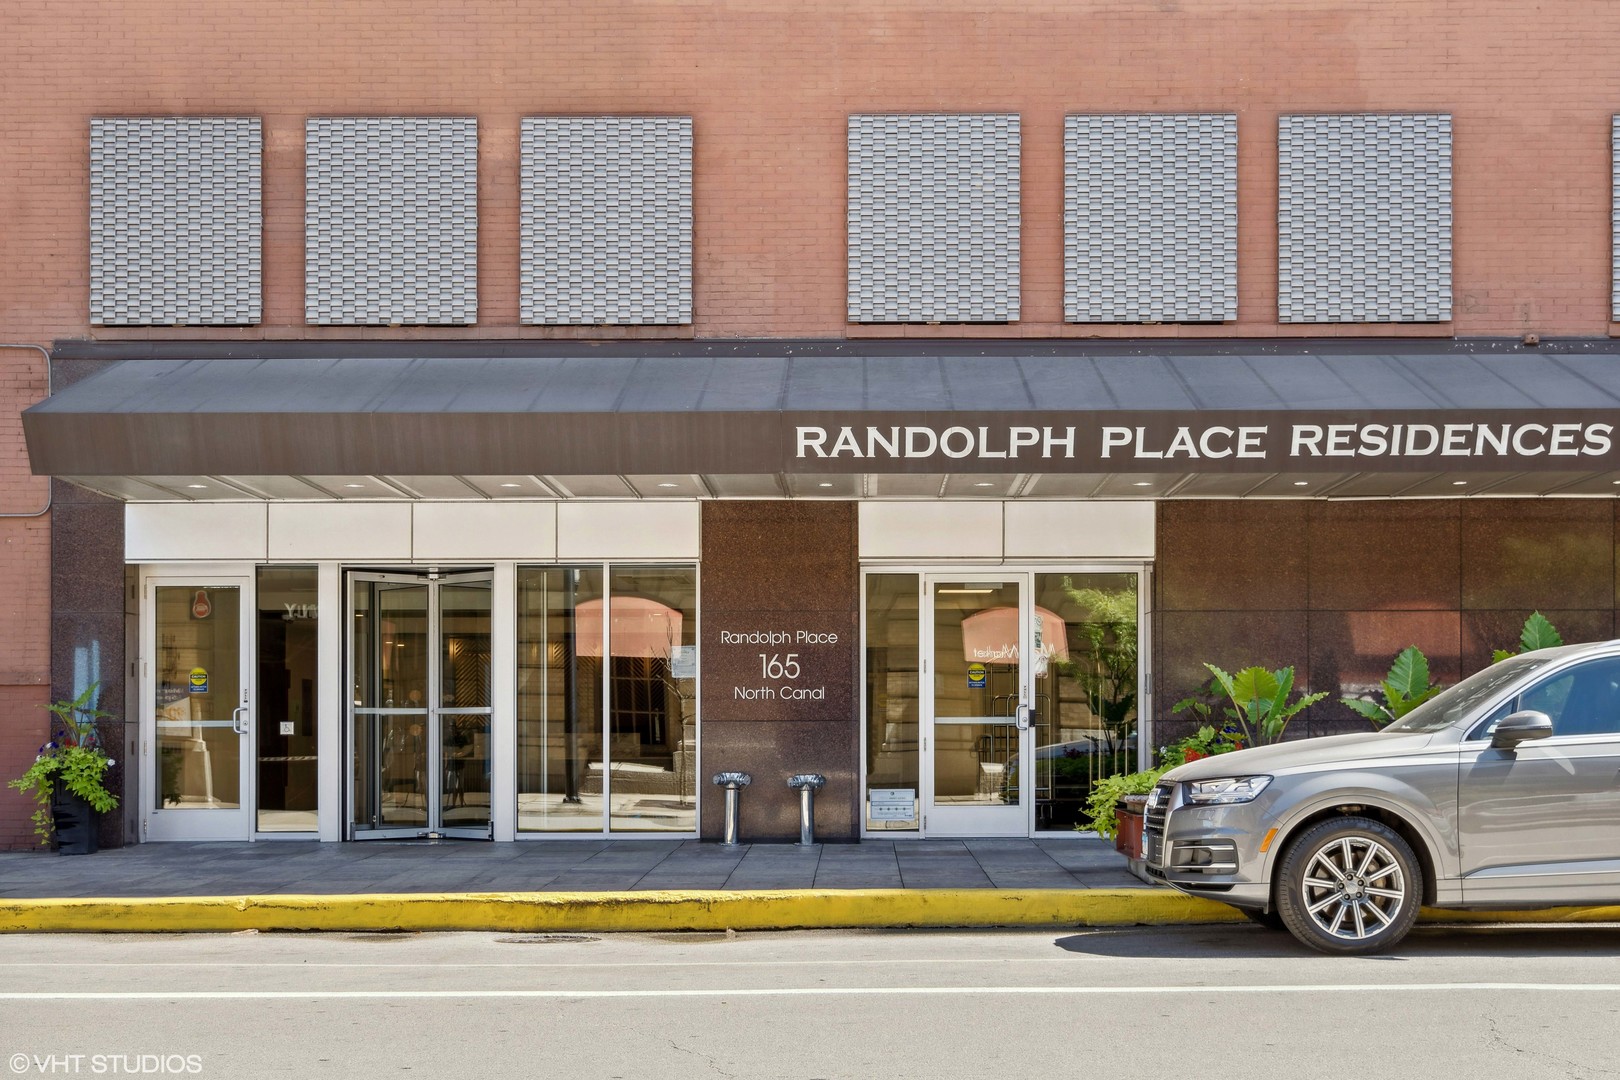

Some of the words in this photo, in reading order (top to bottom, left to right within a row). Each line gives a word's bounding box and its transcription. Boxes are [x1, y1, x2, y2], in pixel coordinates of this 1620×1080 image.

[795, 425, 1076, 460] RANDOLPH
[1099, 424, 1269, 460] PLACE
[1289, 422, 1614, 458] RESIDENCES
[720, 630, 792, 647] Randolph
[796, 630, 839, 644] Place
[759, 653, 801, 679] 165
[734, 685, 776, 700] North
[780, 685, 825, 700] Canal
